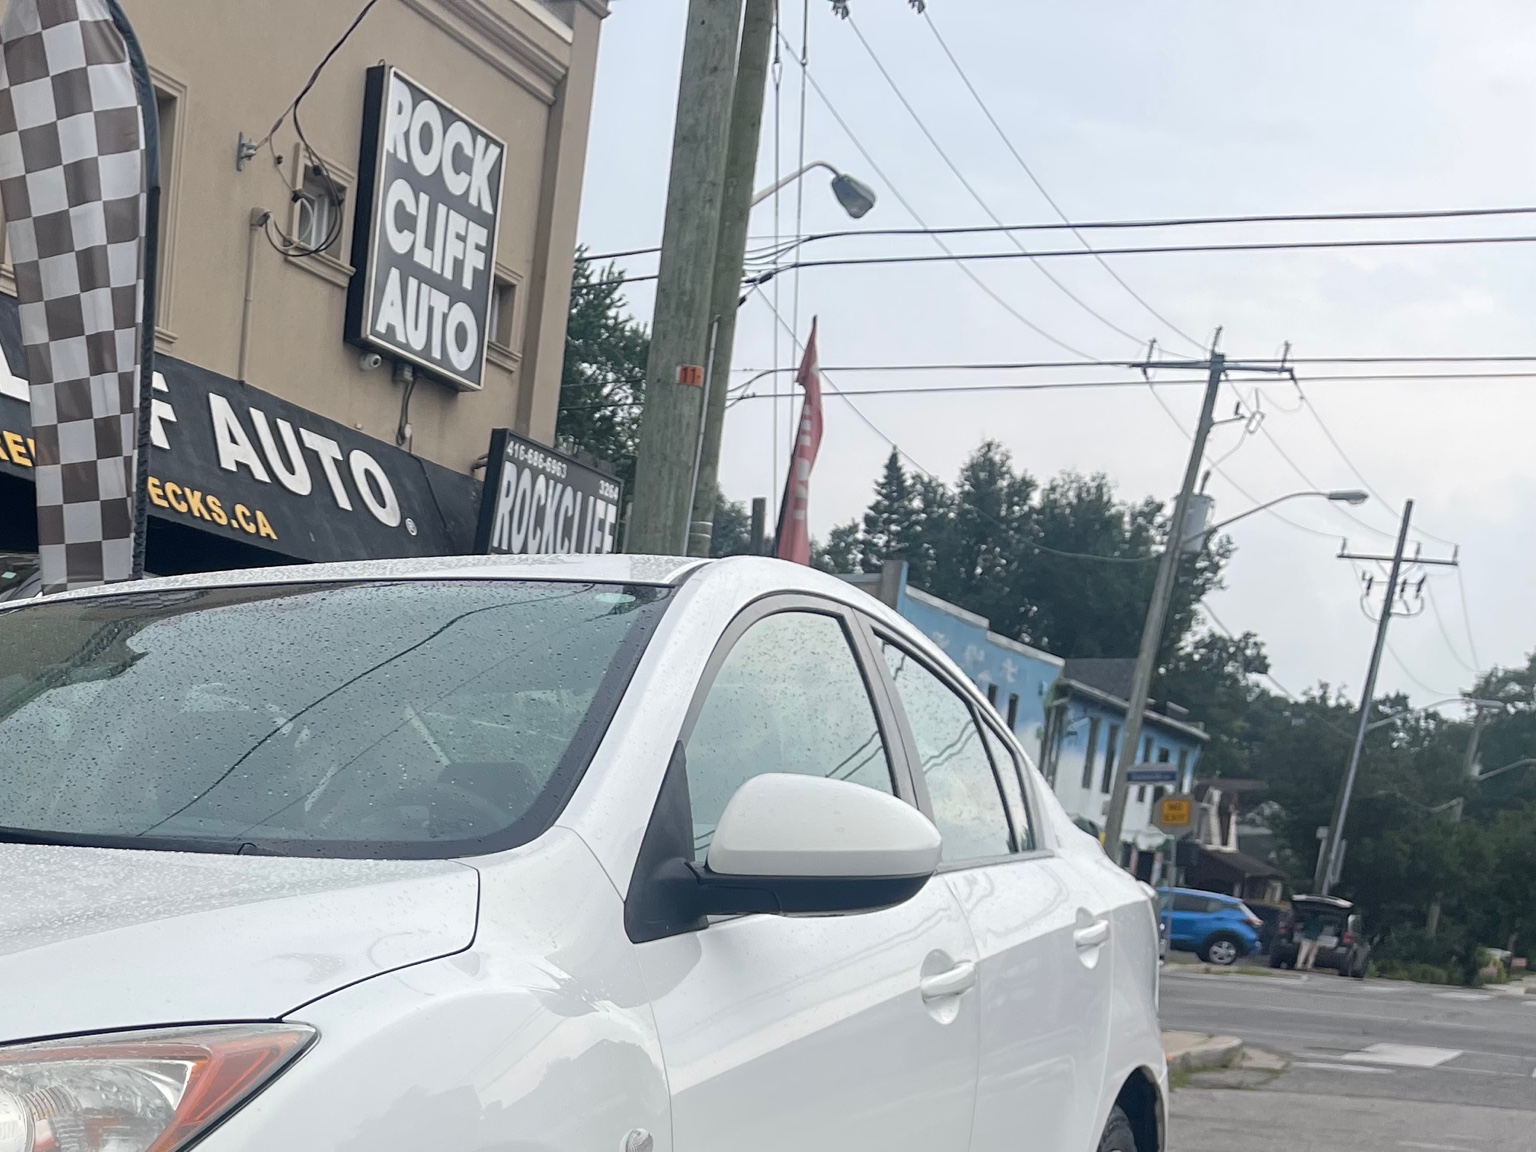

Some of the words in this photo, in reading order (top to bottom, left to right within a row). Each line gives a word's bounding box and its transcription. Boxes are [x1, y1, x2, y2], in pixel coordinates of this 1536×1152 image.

[386, 76, 501, 214] ROCK
[385, 178, 488, 290] CLIFF
[375, 266, 478, 371] AUTO
[147, 476, 278, 540] ECKS.CA
[492, 460, 617, 554] ROCKCLIFF
